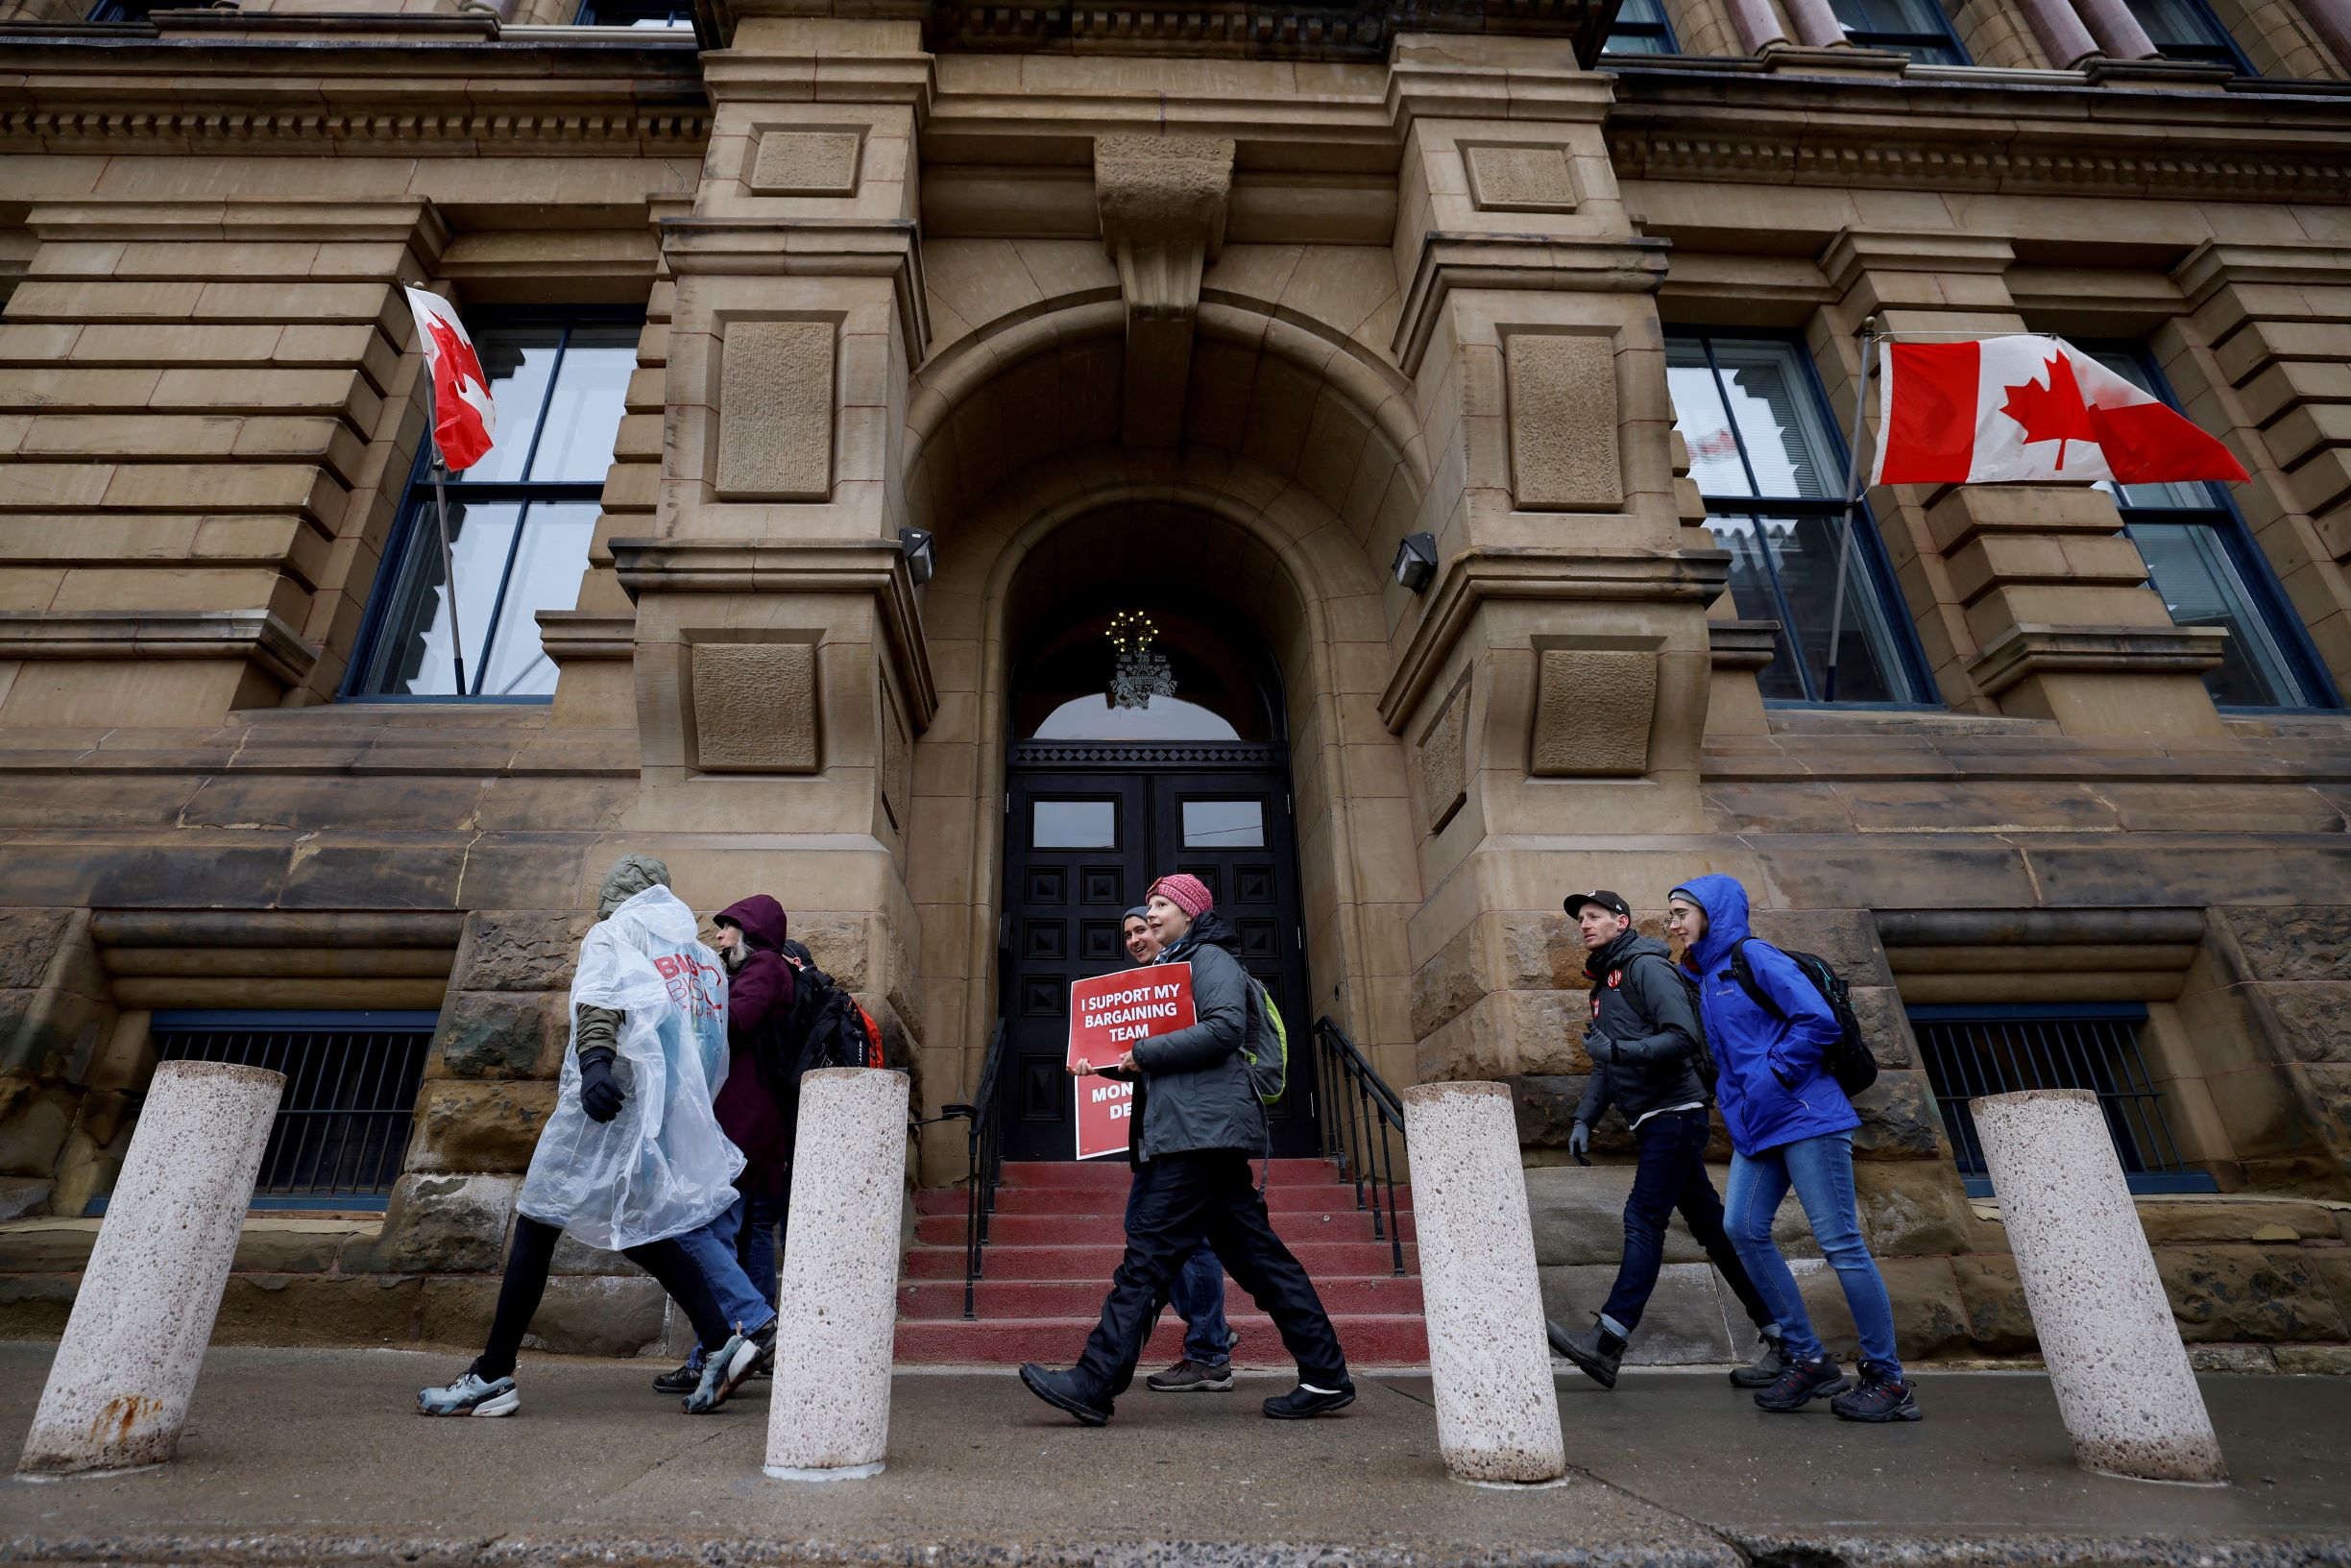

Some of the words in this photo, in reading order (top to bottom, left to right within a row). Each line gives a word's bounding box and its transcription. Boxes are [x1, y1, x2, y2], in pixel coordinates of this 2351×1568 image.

[1081, 999, 1085, 1012] I
[1088, 987, 1151, 1010] SUPPORT
[1153, 983, 1180, 1000] MY
[1084, 1001, 1177, 1028] BARGAINING
[1109, 1024, 1150, 1043] TEAM
